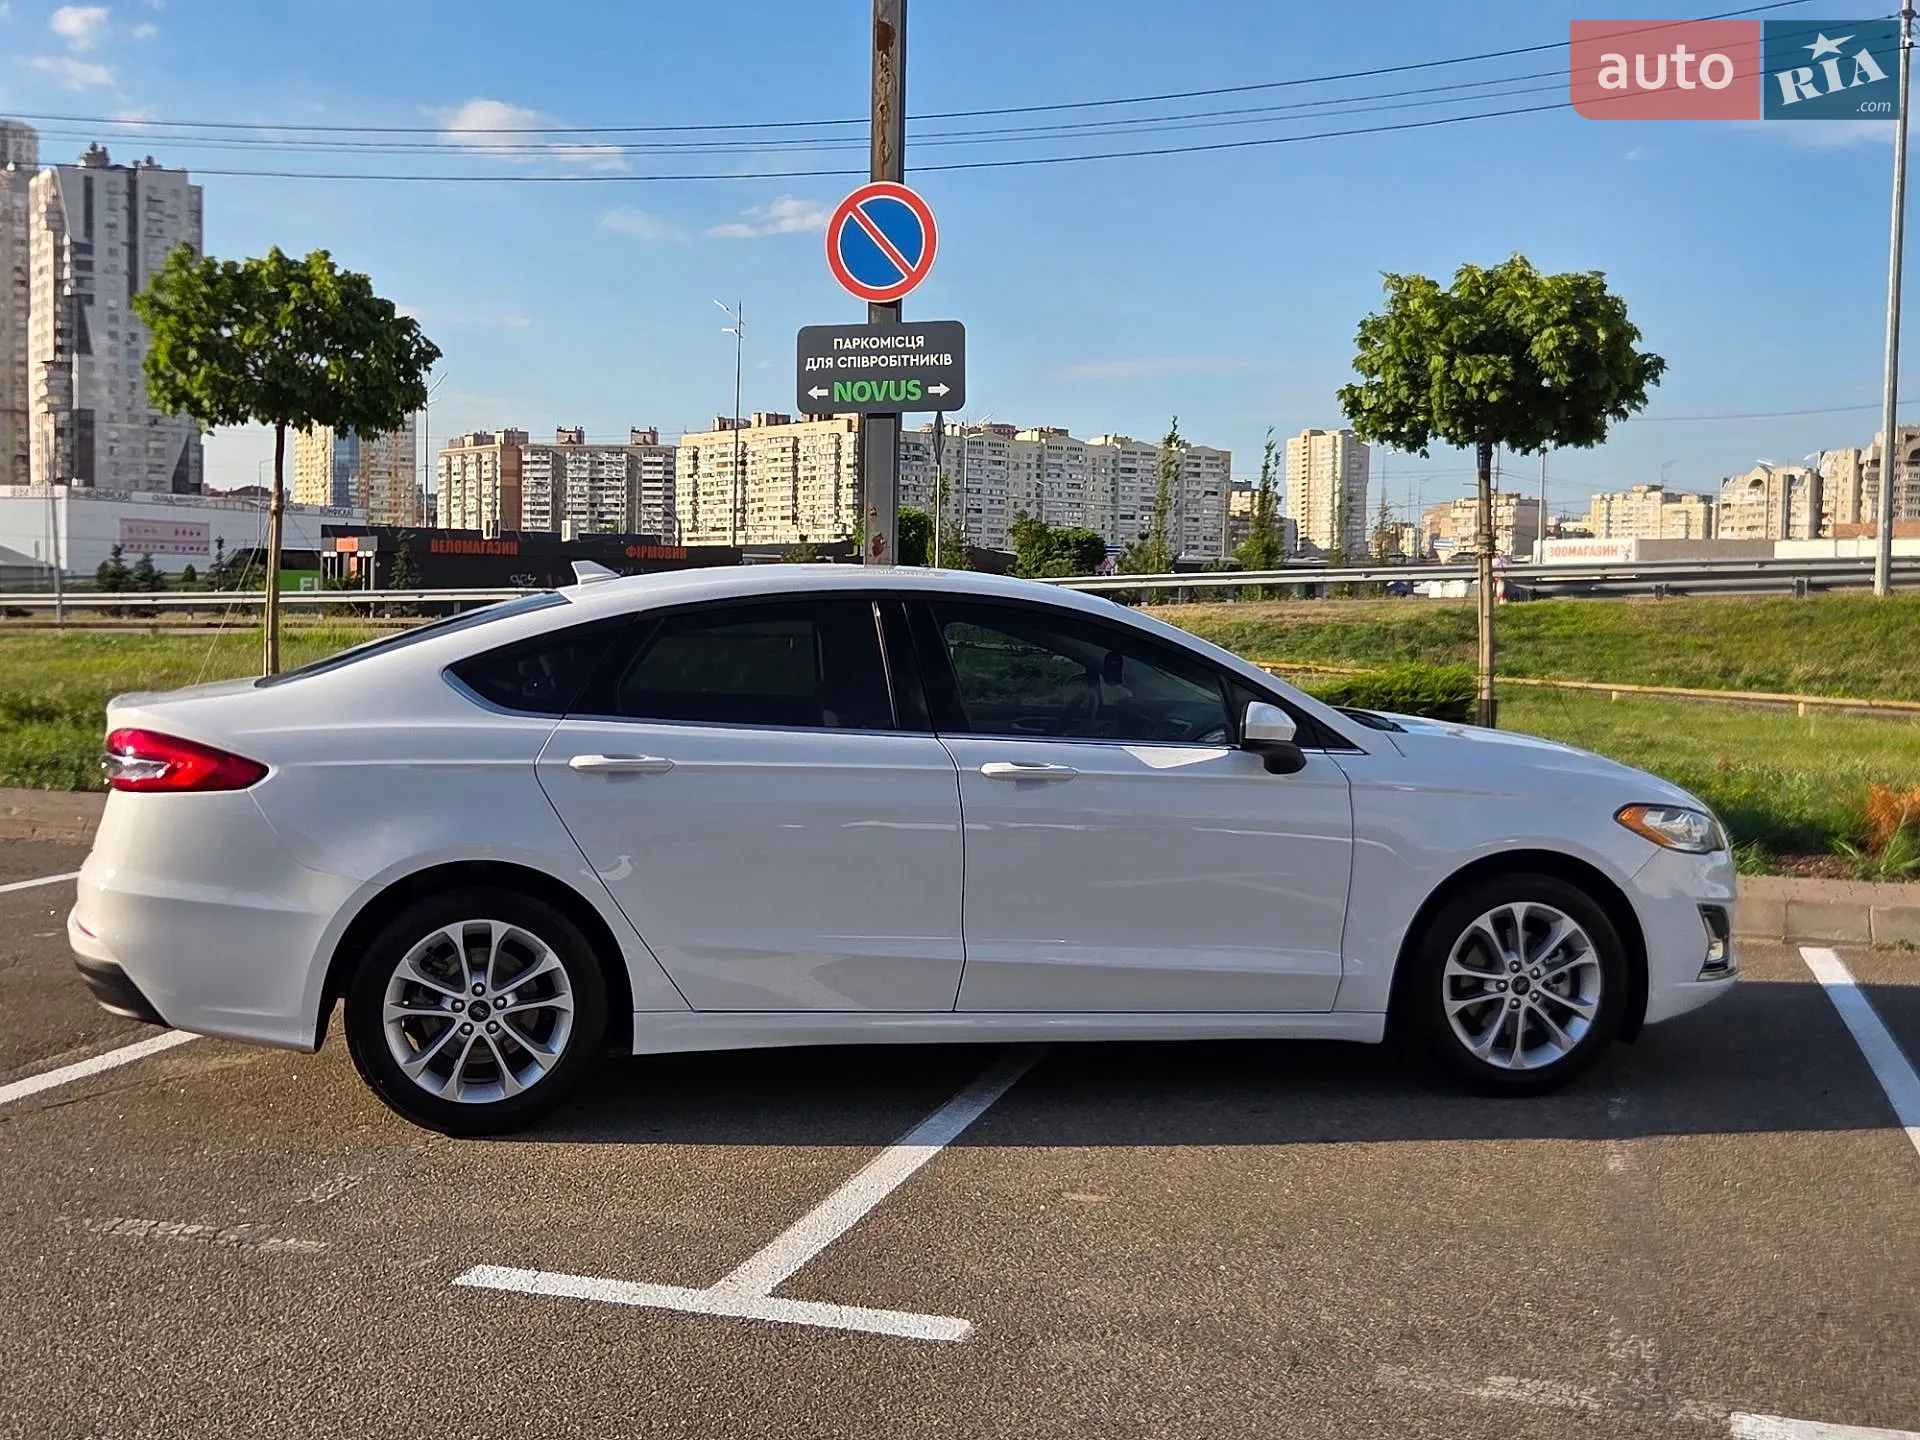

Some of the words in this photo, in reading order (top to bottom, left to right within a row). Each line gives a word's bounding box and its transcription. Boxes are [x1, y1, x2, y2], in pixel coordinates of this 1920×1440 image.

[833, 335, 925, 350] ПАРКОМІСЦЯ
[805, 356, 834, 371] ДЛЯ
[837, 353, 953, 369] СПІВРОБІТНИКІВ
[833, 379, 922, 402] NOVUS
[430, 539, 518, 555] ВЕЛОМАГАЗИН
[1548, 544, 1619, 557] ЗООМАГАЗИН
